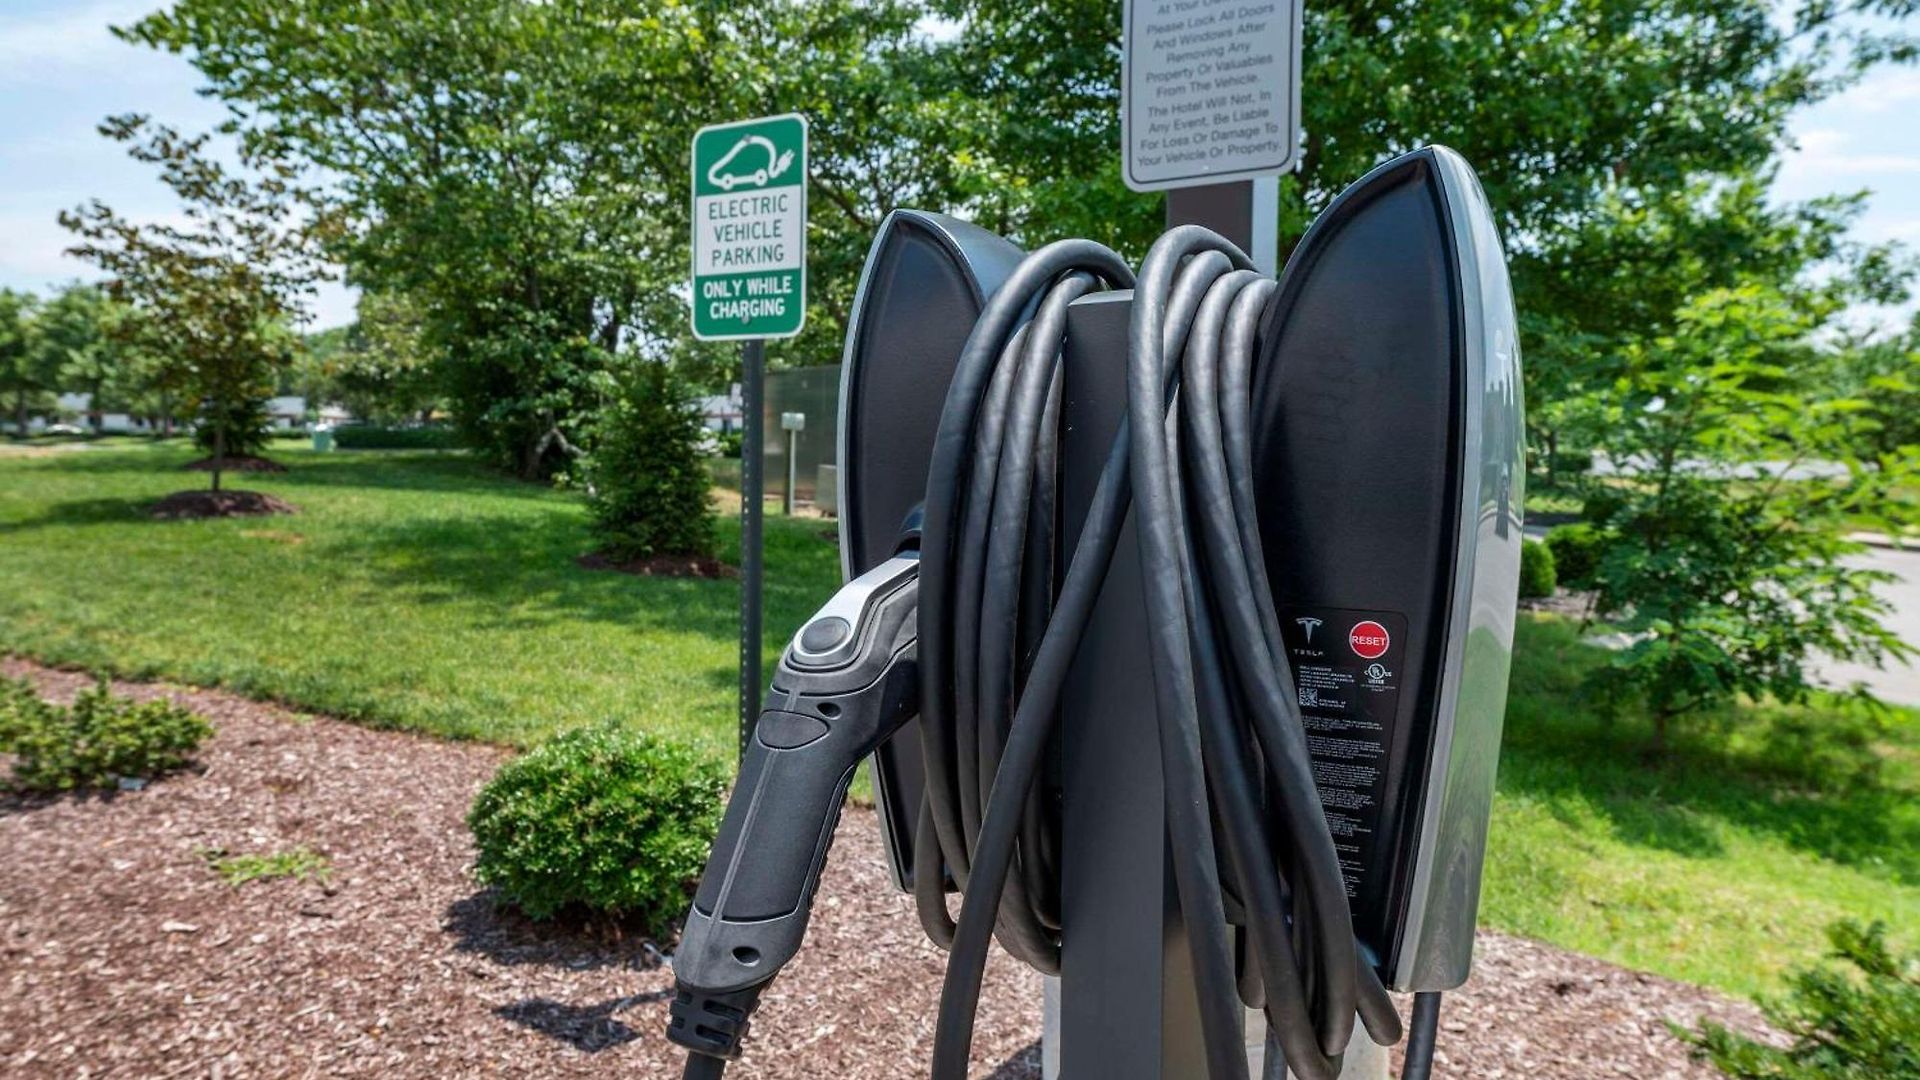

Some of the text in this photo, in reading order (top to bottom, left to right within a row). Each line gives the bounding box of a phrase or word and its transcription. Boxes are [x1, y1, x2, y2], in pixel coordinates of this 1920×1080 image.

[1157, 5, 1170, 14] At
[1174, 0, 1199, 12] Your
[1147, 4, 1275, 35] Please Lock All Doors
[1153, 22, 1266, 50] And Windows After
[1166, 42, 1250, 64] Removing Any
[1146, 54, 1273, 83] Property Or Valuables
[1157, 85, 1186, 98] From
[1190, 80, 1212, 92] The
[1148, 105, 1168, 117] The
[1171, 99, 1203, 114] Hotel
[1206, 97, 1227, 110] Will
[1149, 121, 1170, 134] Any
[1213, 112, 1229, 125] Be
[1233, 107, 1269, 122] Liable
[1140, 122, 1278, 151] For Loss Or Damage To
[1138, 141, 1281, 167] Your Vehicle Or Property.
[709, 194, 789, 220] ELECTRIC
[713, 220, 783, 243] VEHICLE
[712, 244, 784, 268] PARKING
[703, 276, 793, 298] ONLY WHILE
[709, 298, 786, 320] CHARGING
[1352, 635, 1386, 646] RESET
